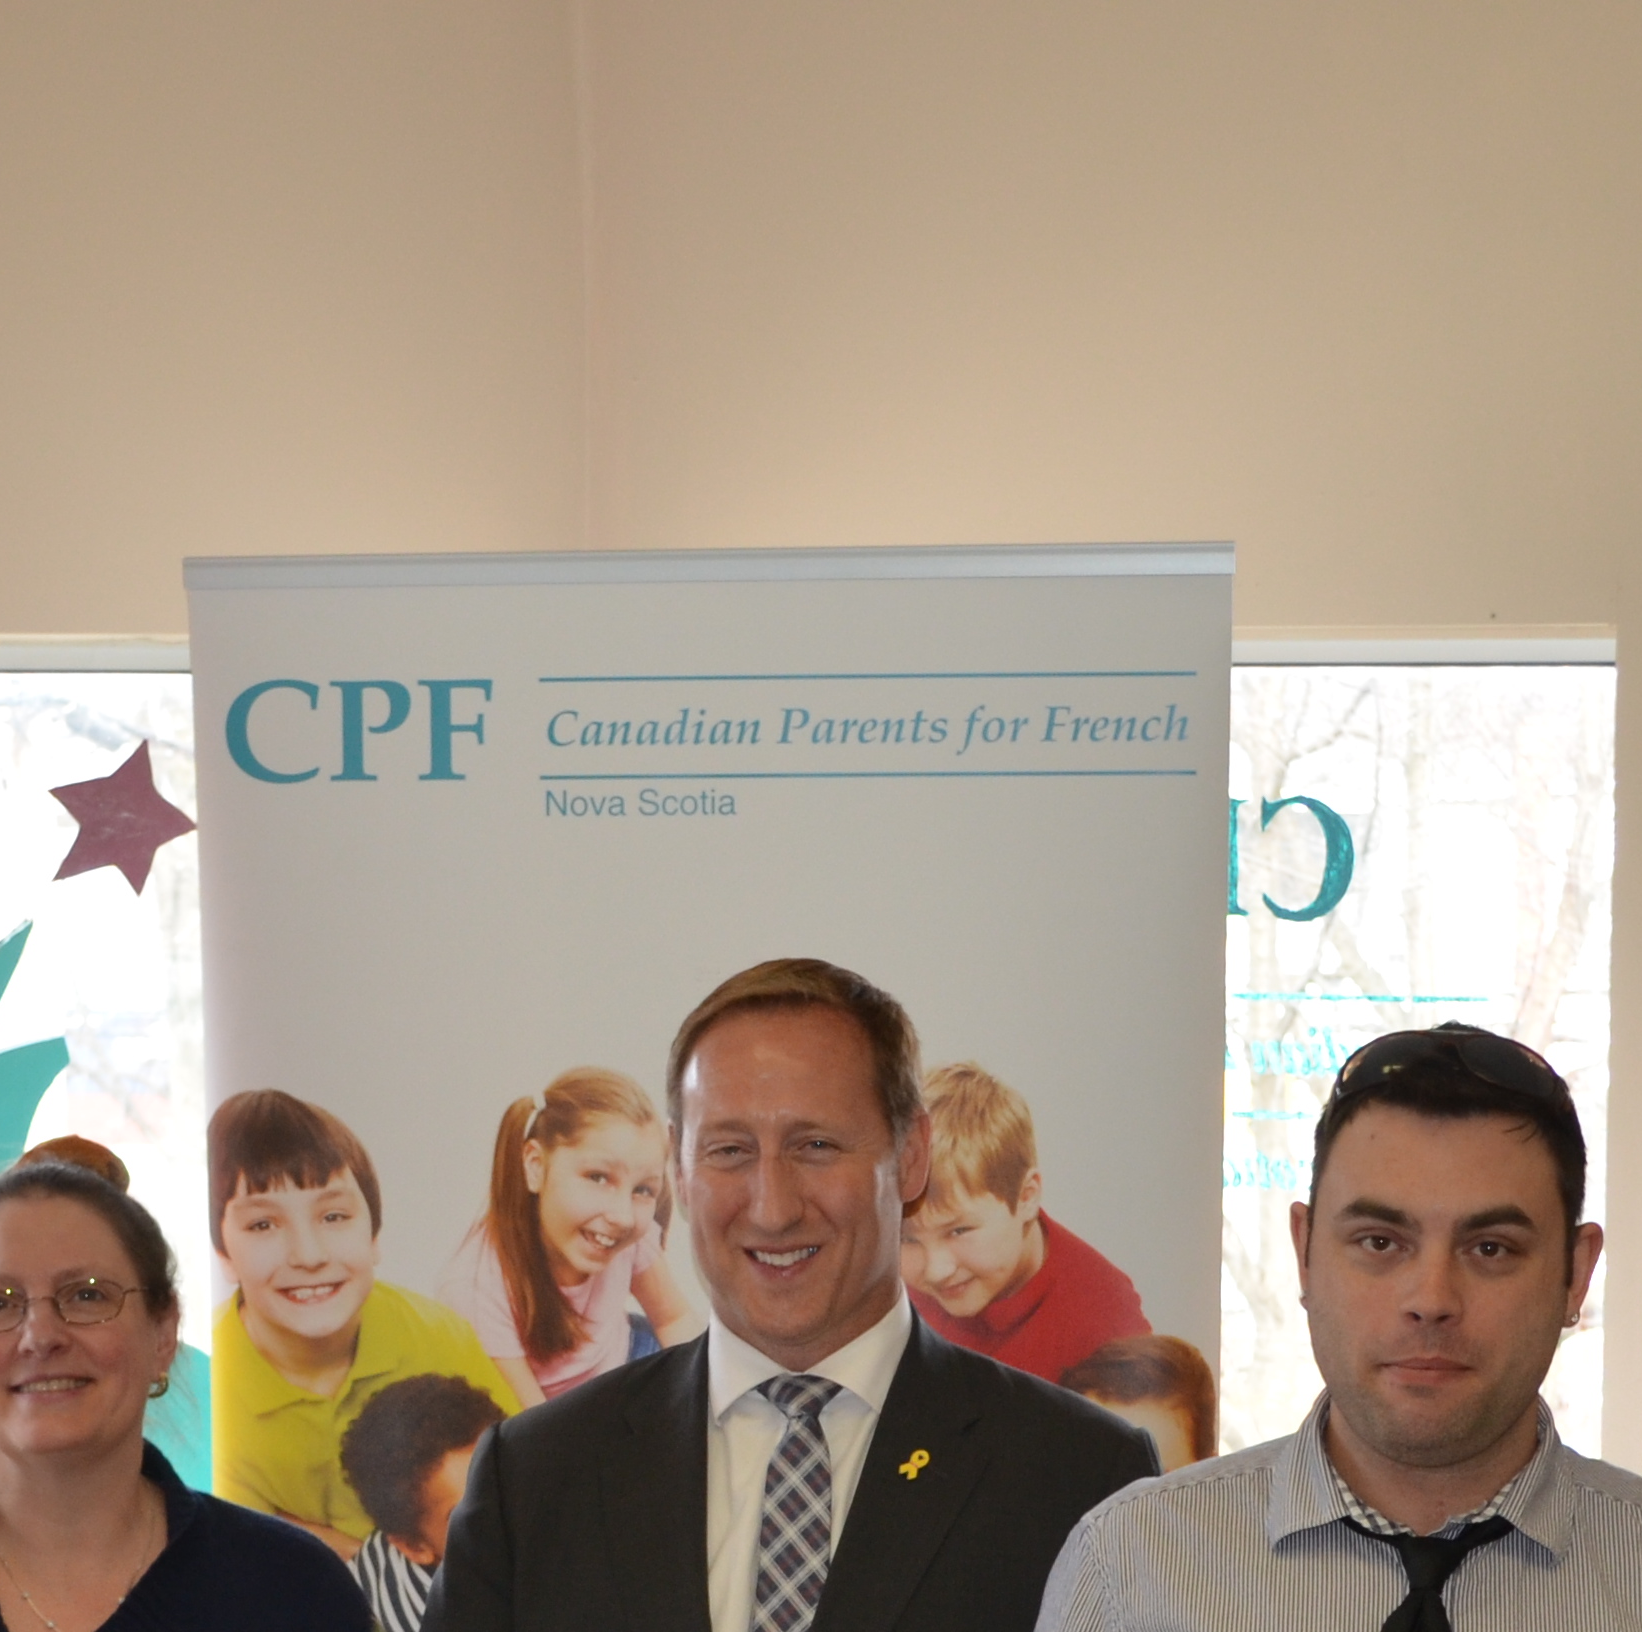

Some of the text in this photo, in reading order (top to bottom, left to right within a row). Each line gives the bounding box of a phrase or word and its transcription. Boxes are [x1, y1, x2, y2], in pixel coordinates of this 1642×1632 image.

[223, 678, 494, 785] CPF
[546, 702, 1191, 757] Canadian Parents for French
[545, 786, 738, 818] Nova Scotia
